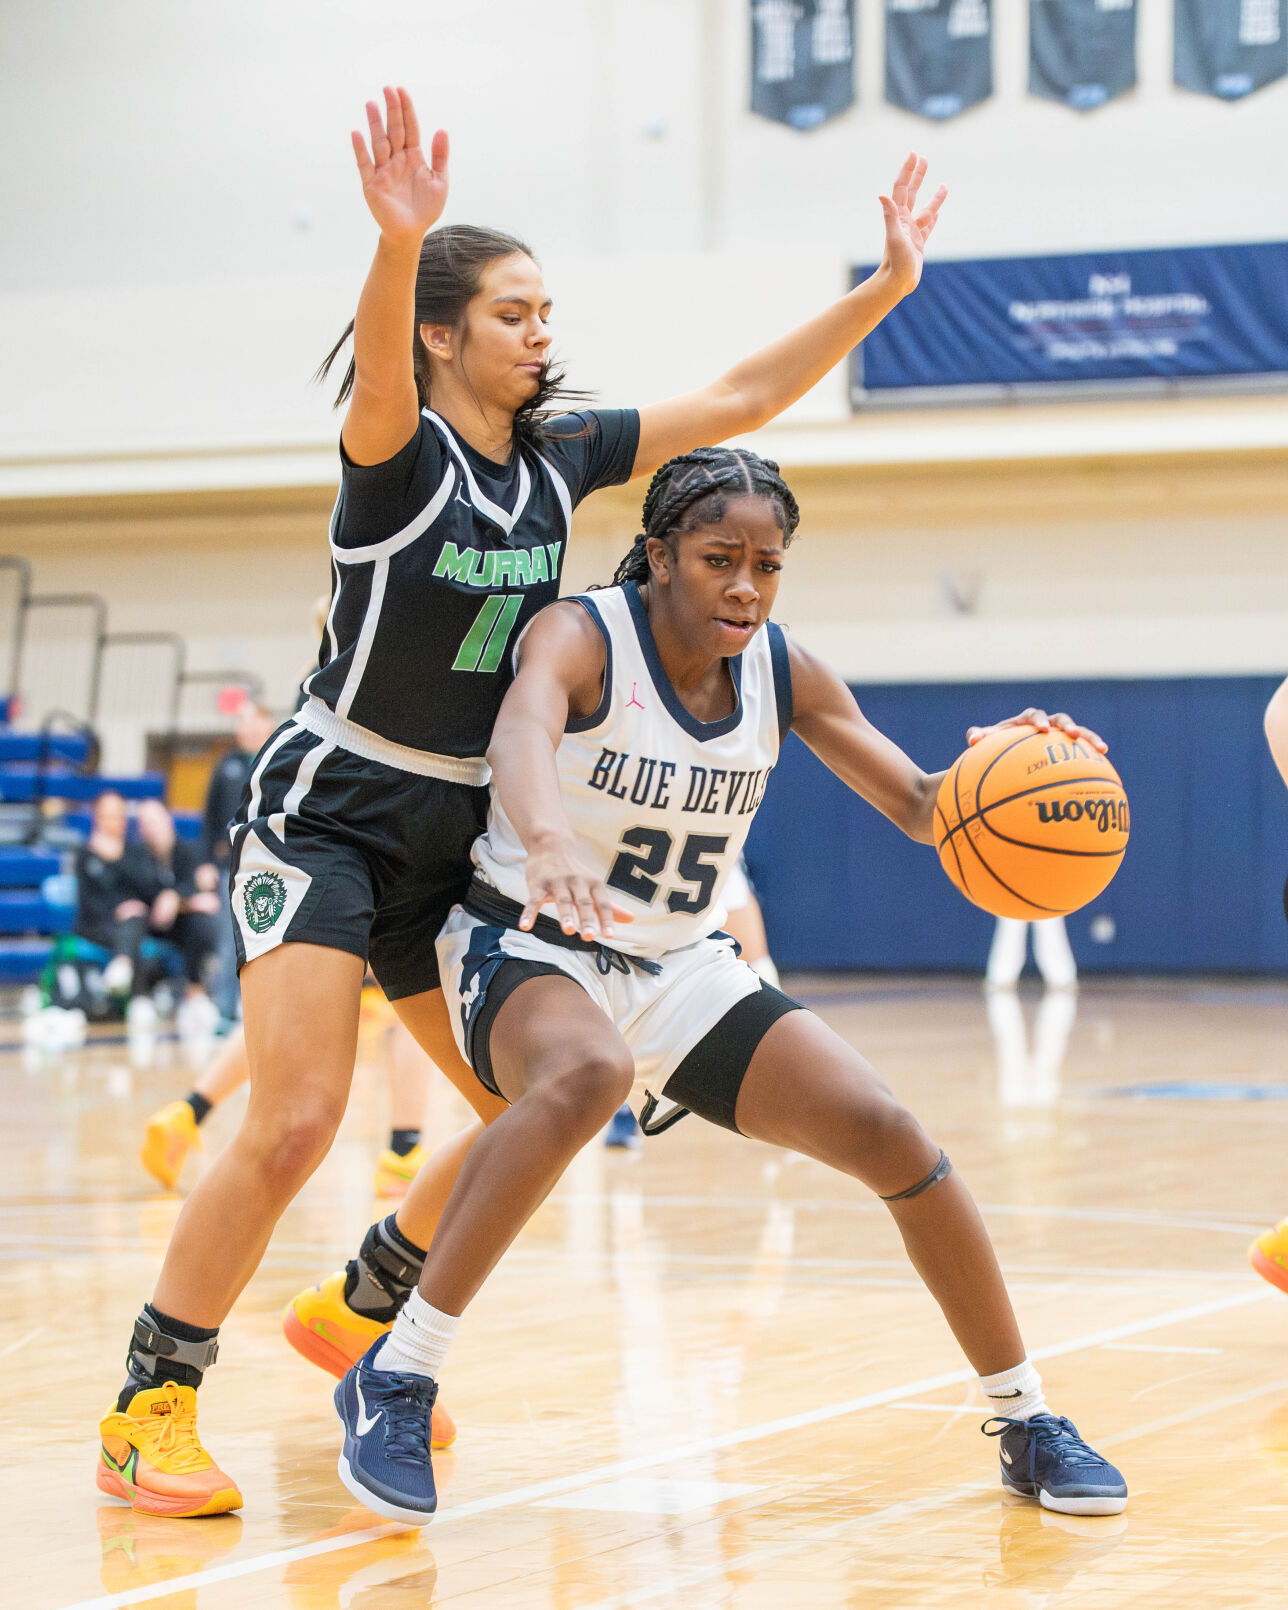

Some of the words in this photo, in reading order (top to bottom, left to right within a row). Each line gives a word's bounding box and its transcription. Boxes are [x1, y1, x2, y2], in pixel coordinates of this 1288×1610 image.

[432, 541, 562, 587] MURRAY
[451, 594, 525, 673] 11
[587, 747, 677, 810] BLUE
[1034, 799, 1130, 833] Wilson
[605, 824, 733, 918] 25
